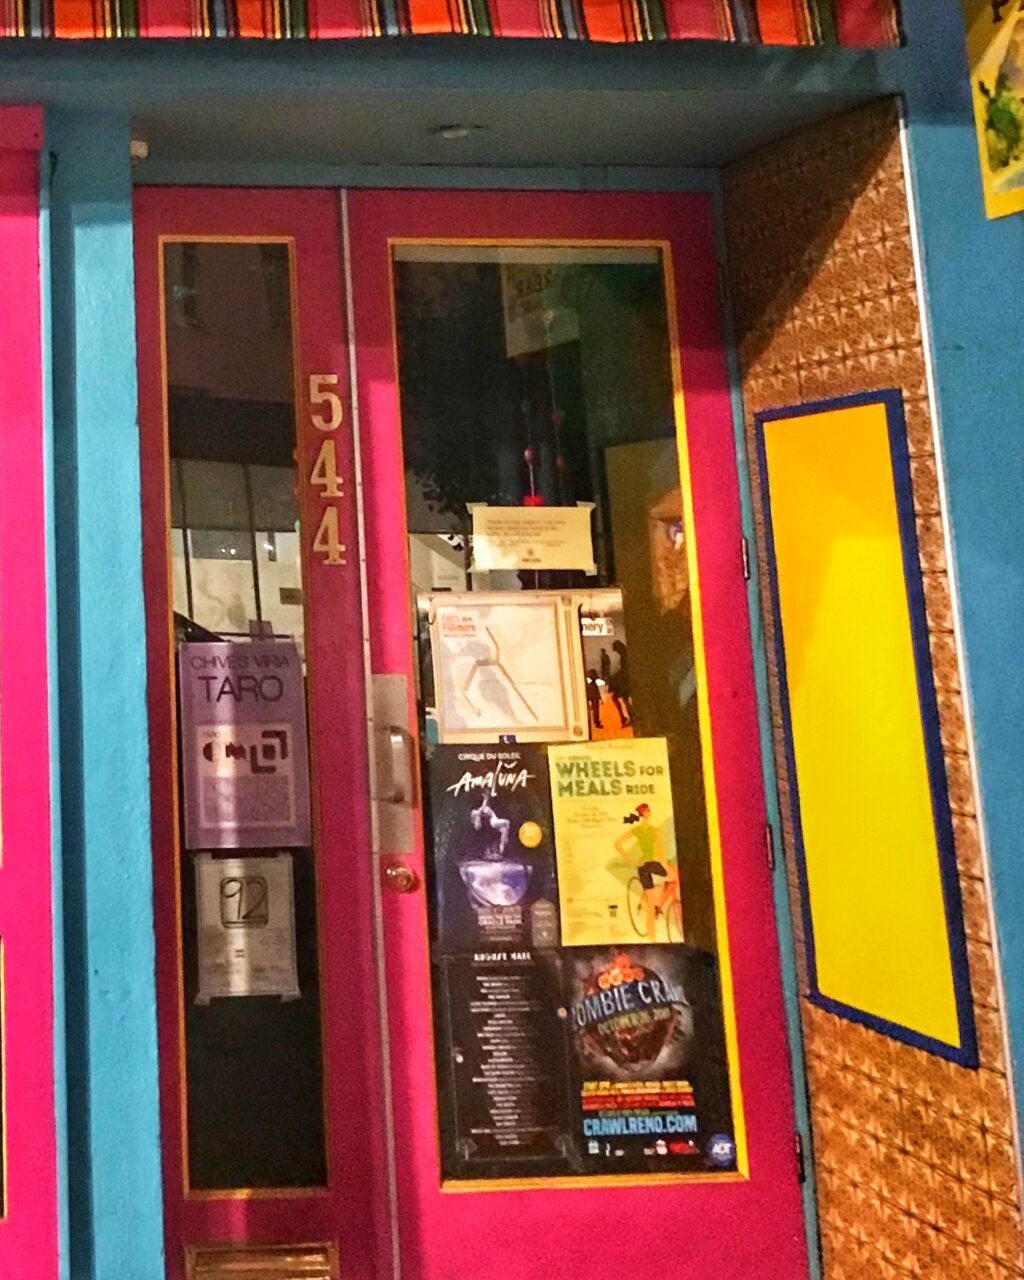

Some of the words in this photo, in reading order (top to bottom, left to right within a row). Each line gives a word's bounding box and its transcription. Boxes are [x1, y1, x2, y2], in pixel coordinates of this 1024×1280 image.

[309, 374, 347, 565] 544
[197, 675, 284, 702] TARO
[556, 760, 637, 778] WHEELS
[640, 765, 664, 776] FOR
[558, 780, 623, 797] MEALS
[626, 784, 656, 795] RIDE
[583, 1114, 698, 1136] CRAWLRENO.COM
